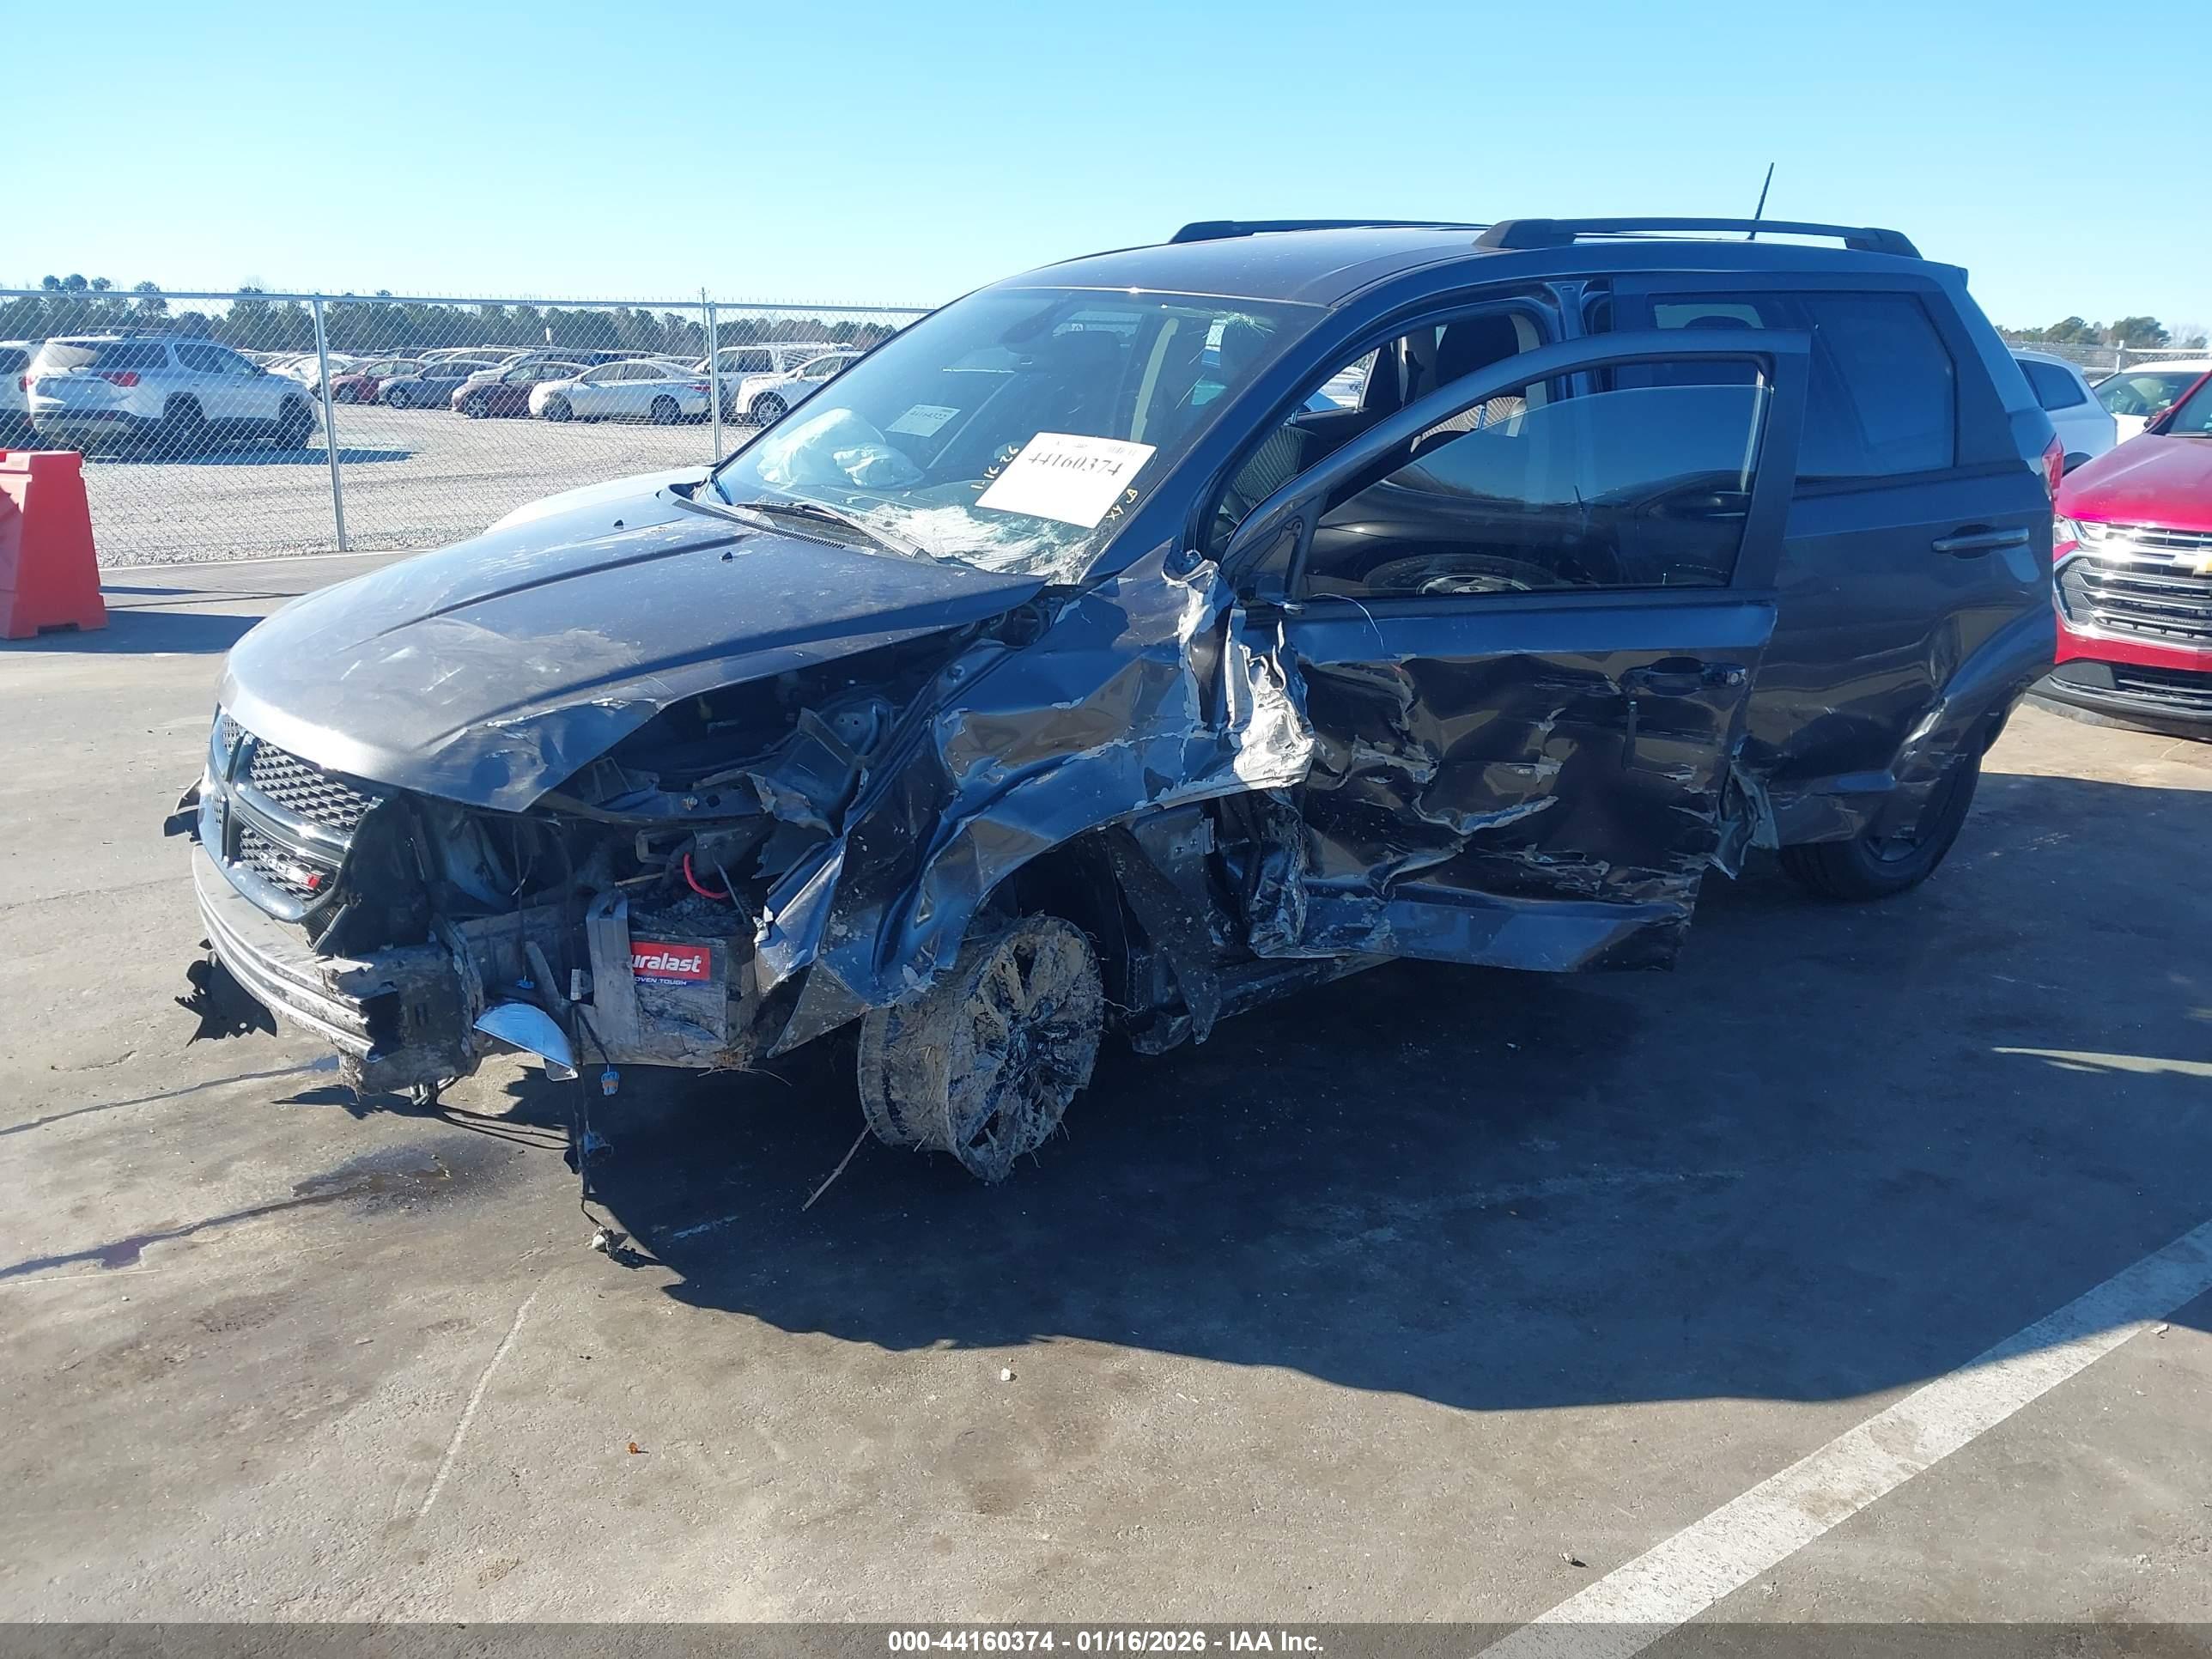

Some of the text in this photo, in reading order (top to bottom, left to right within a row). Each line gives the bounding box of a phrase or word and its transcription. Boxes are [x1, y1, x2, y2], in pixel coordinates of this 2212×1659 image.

[1028, 452, 1123, 477] 44160374
[631, 952, 702, 973] uralast
[659, 978, 687, 987] TOUGH
